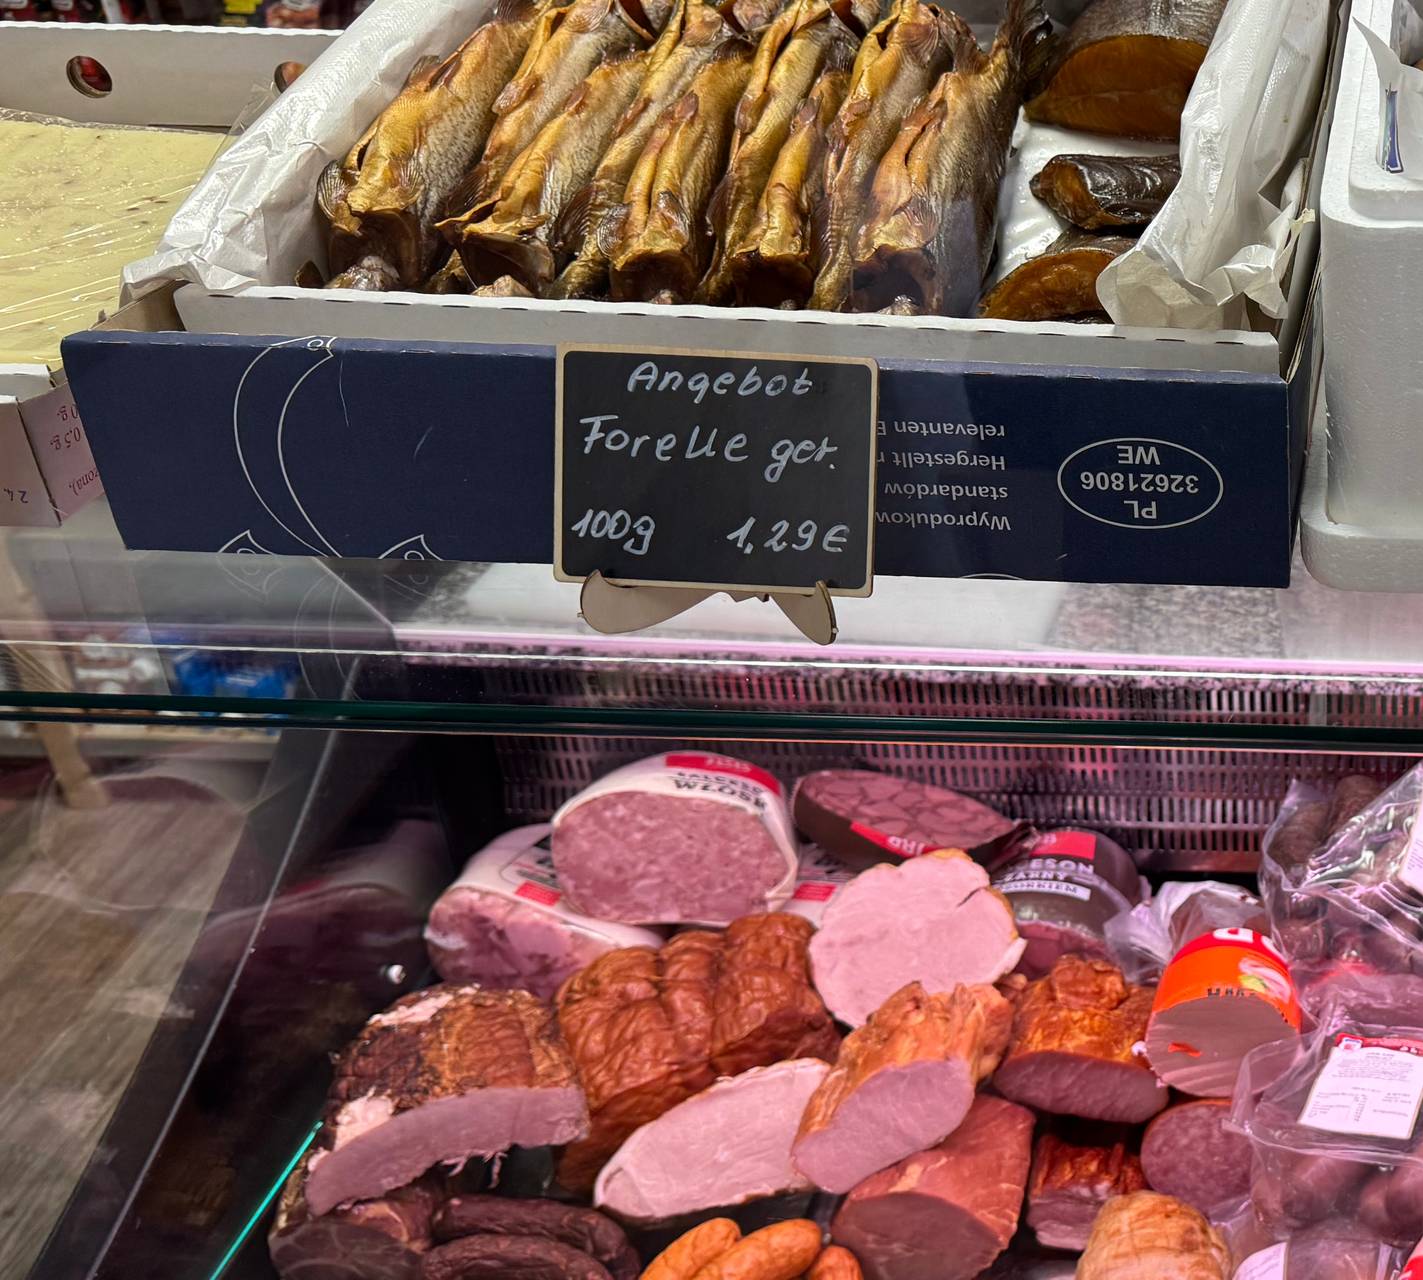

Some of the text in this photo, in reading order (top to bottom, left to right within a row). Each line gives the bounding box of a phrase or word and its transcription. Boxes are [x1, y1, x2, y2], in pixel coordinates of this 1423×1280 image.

[627, 361, 813, 404] Angebot
[893, 420, 1006, 441] relevanten
[580, 414, 838, 483] Forelle ger.
[1117, 445, 1161, 466] WE
[891, 451, 1006, 471] Hergestellt
[884, 481, 1009, 500] standardów
[1080, 470, 1200, 494] 32621806
[1123, 500, 1157, 520] PL
[571, 509, 850, 555] 100g 1,29€
